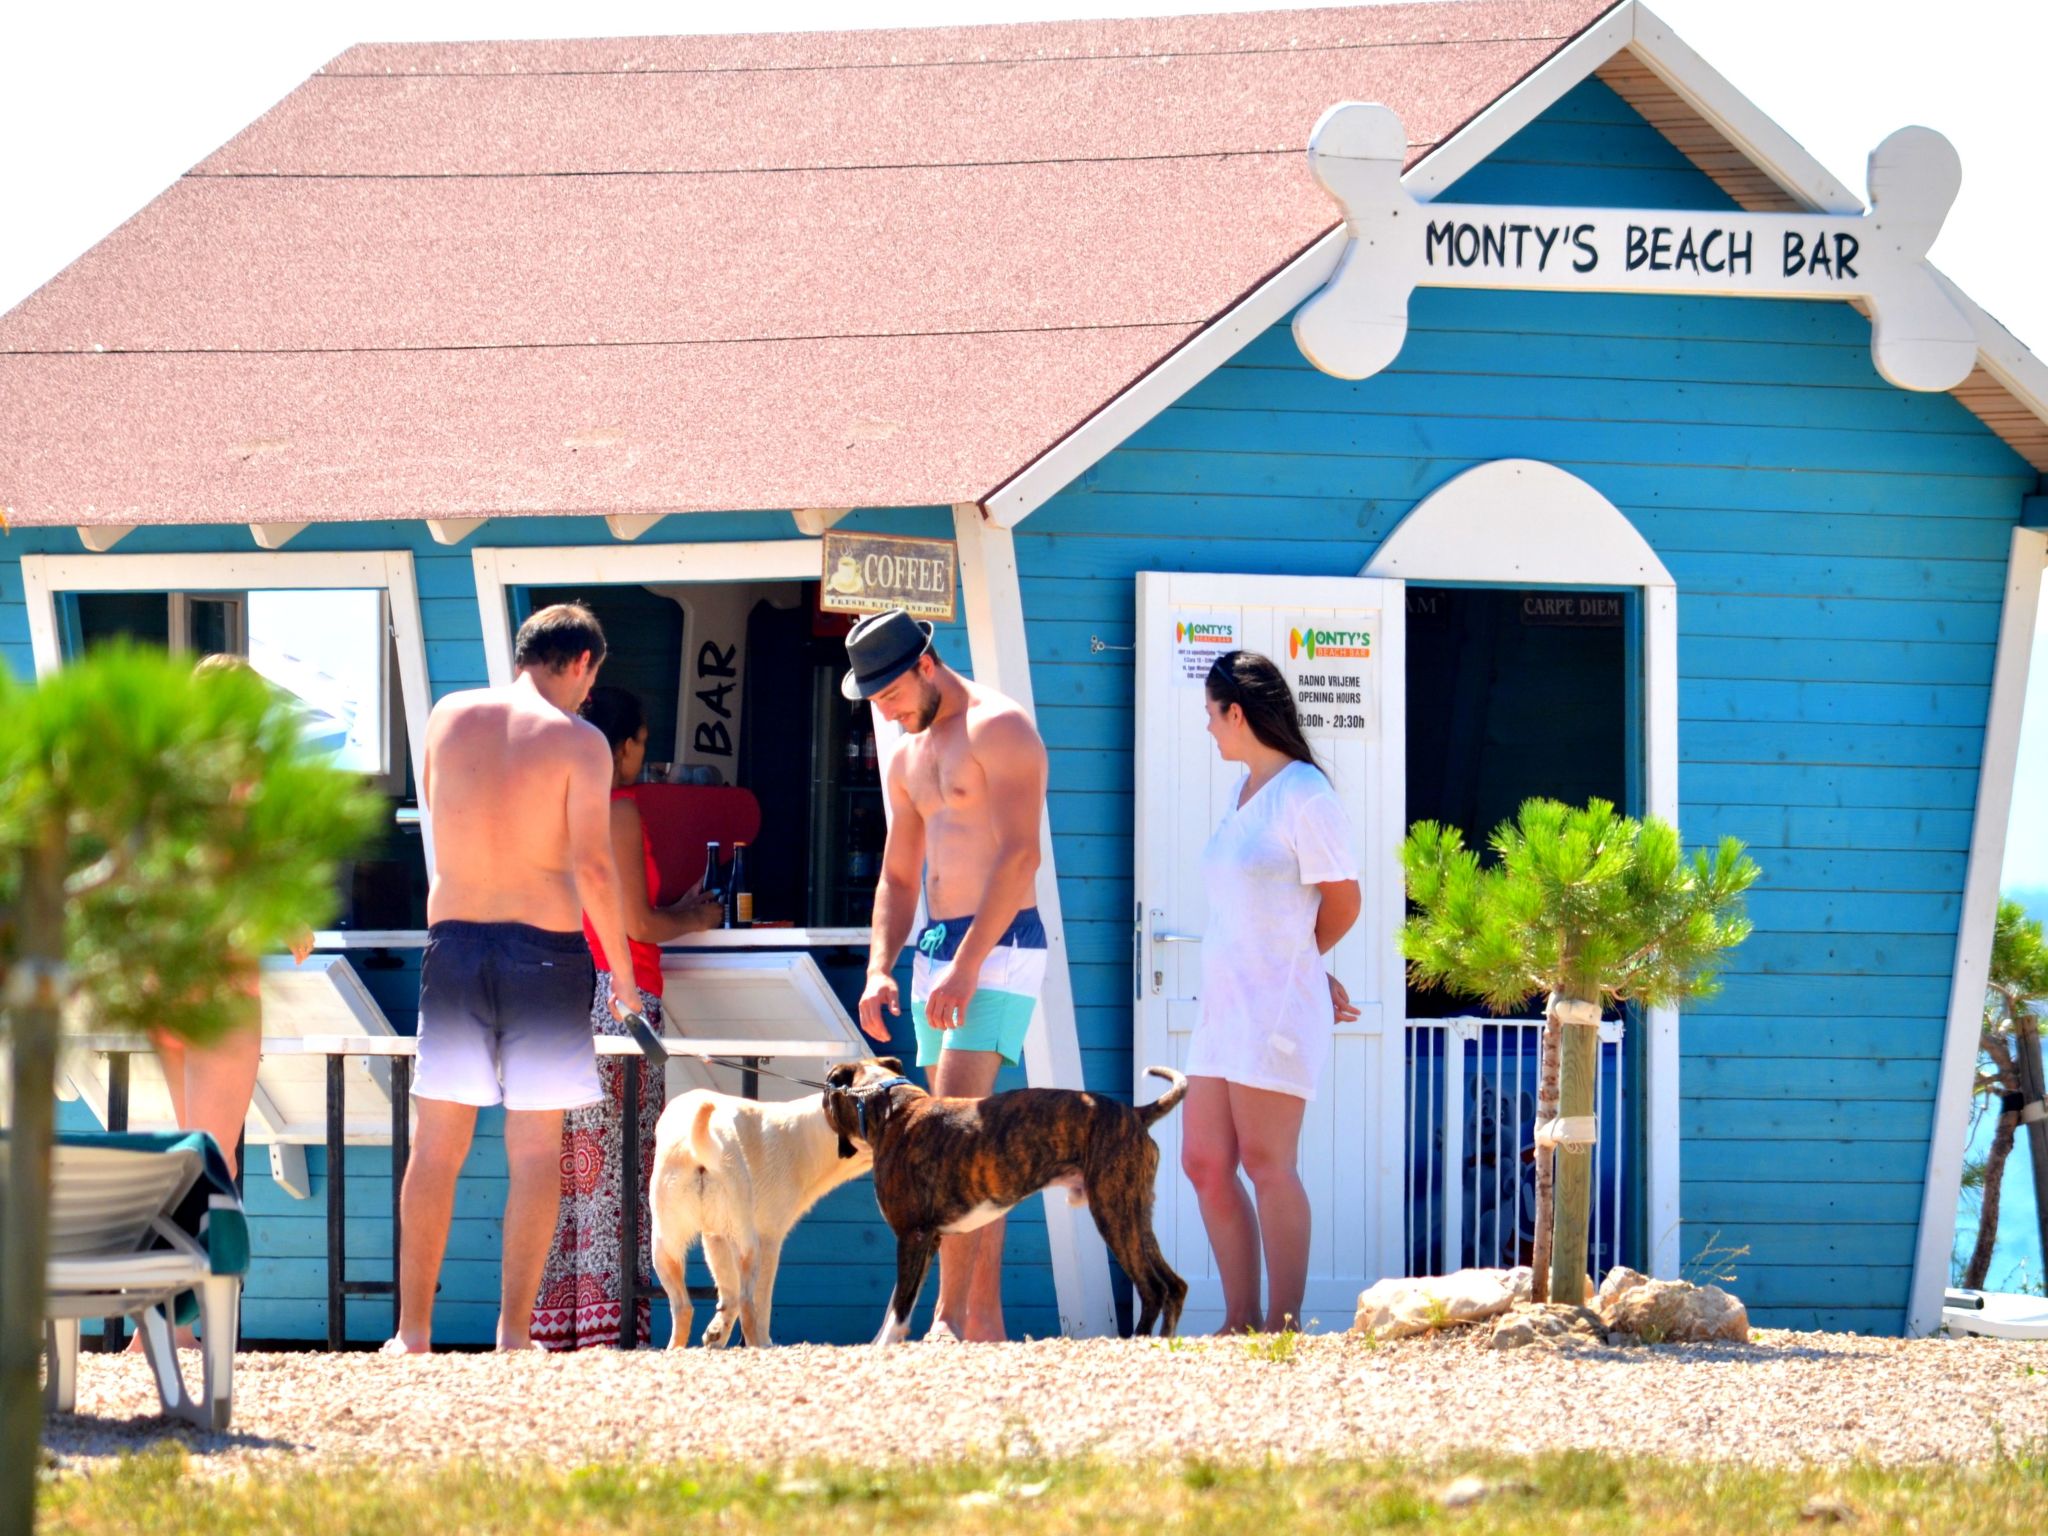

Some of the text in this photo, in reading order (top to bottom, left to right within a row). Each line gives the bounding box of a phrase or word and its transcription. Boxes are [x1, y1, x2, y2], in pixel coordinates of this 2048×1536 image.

[1425, 219, 1859, 280] MONTY'S BEACH BAR
[864, 553, 945, 592] COFFEE
[1523, 598, 1620, 616] CARPE DIEM
[1176, 621, 1233, 644] MONTY'S
[1290, 627, 1370, 660] MONTY'S
[1317, 648, 1367, 657] BEACH BAR
[1298, 675, 1361, 688] RADNO VRIJEME
[694, 640, 736, 757] BAR
[1298, 691, 1361, 704] OPENING HOURS
[1297, 713, 1324, 728] 0:00h
[1333, 714, 1365, 729] 20:30h
